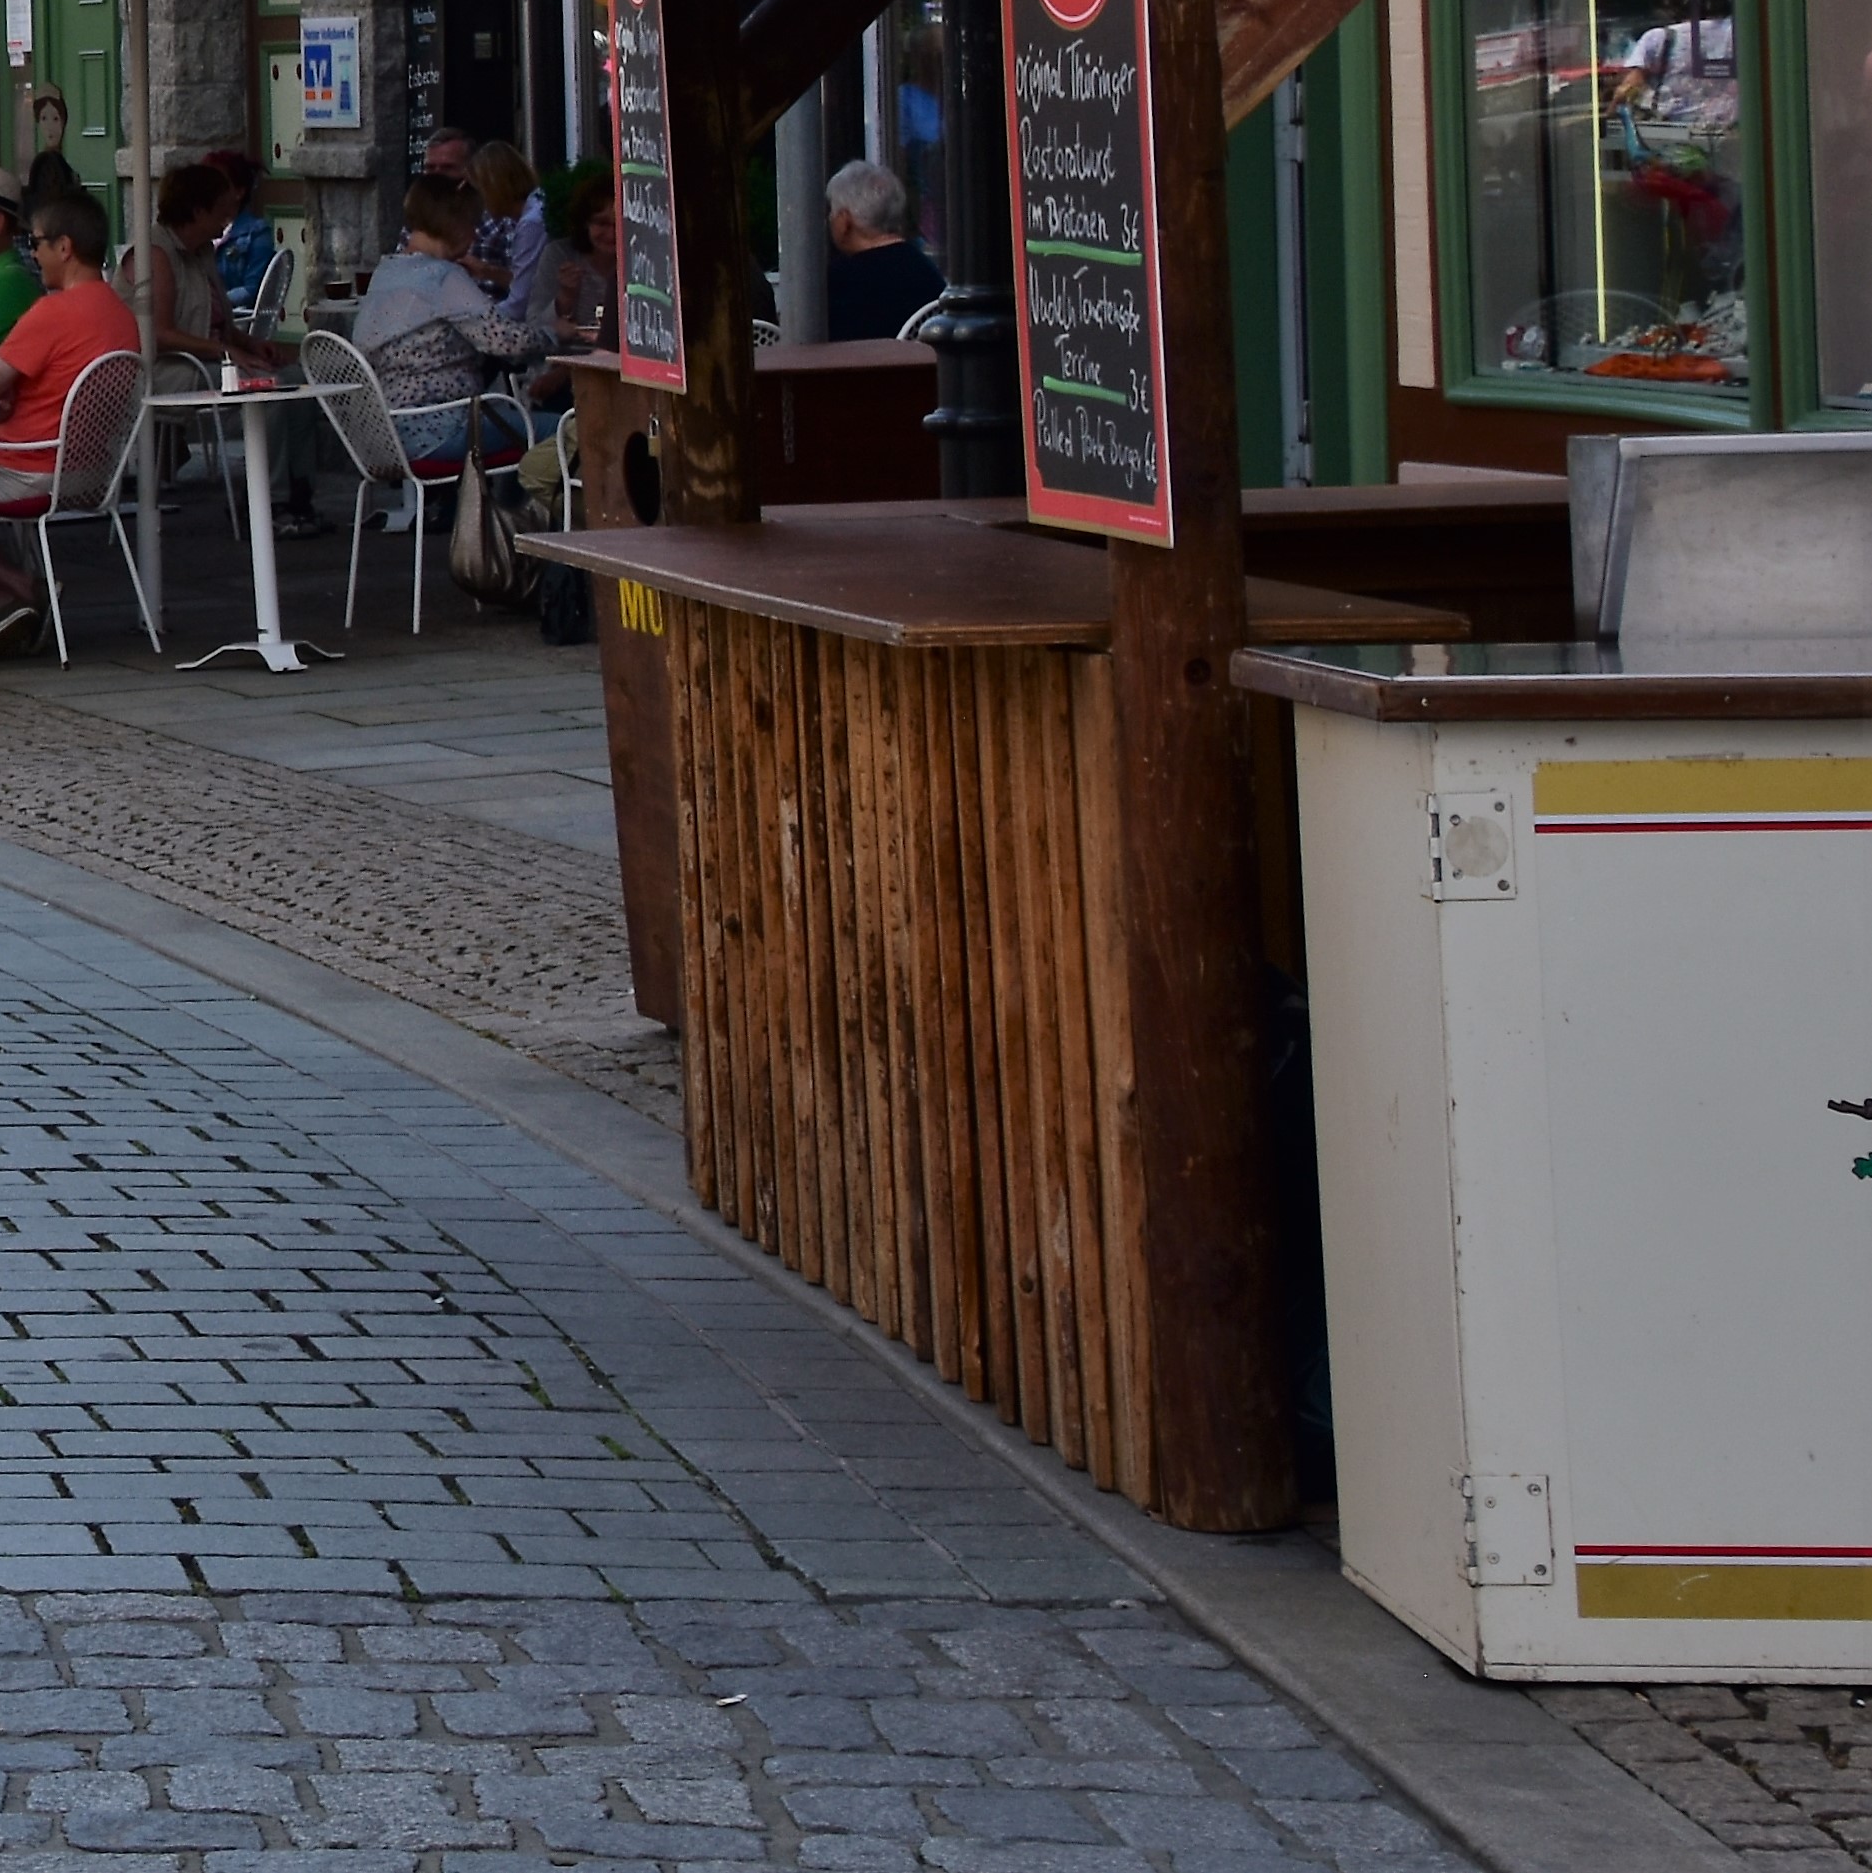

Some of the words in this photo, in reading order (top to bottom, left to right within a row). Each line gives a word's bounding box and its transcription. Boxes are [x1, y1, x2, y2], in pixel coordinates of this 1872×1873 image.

[1065, 39, 1136, 116] Thüringer
[1019, 114, 1116, 186] Rostbratwurst
[1026, 192, 1043, 232] im
[1045, 194, 1109, 241] Brötchen
[1120, 203, 1140, 251] 3€
[1054, 333, 1101, 386] Terrine
[1129, 368, 1149, 414] 3€
[1105, 420, 1141, 489] Burger
